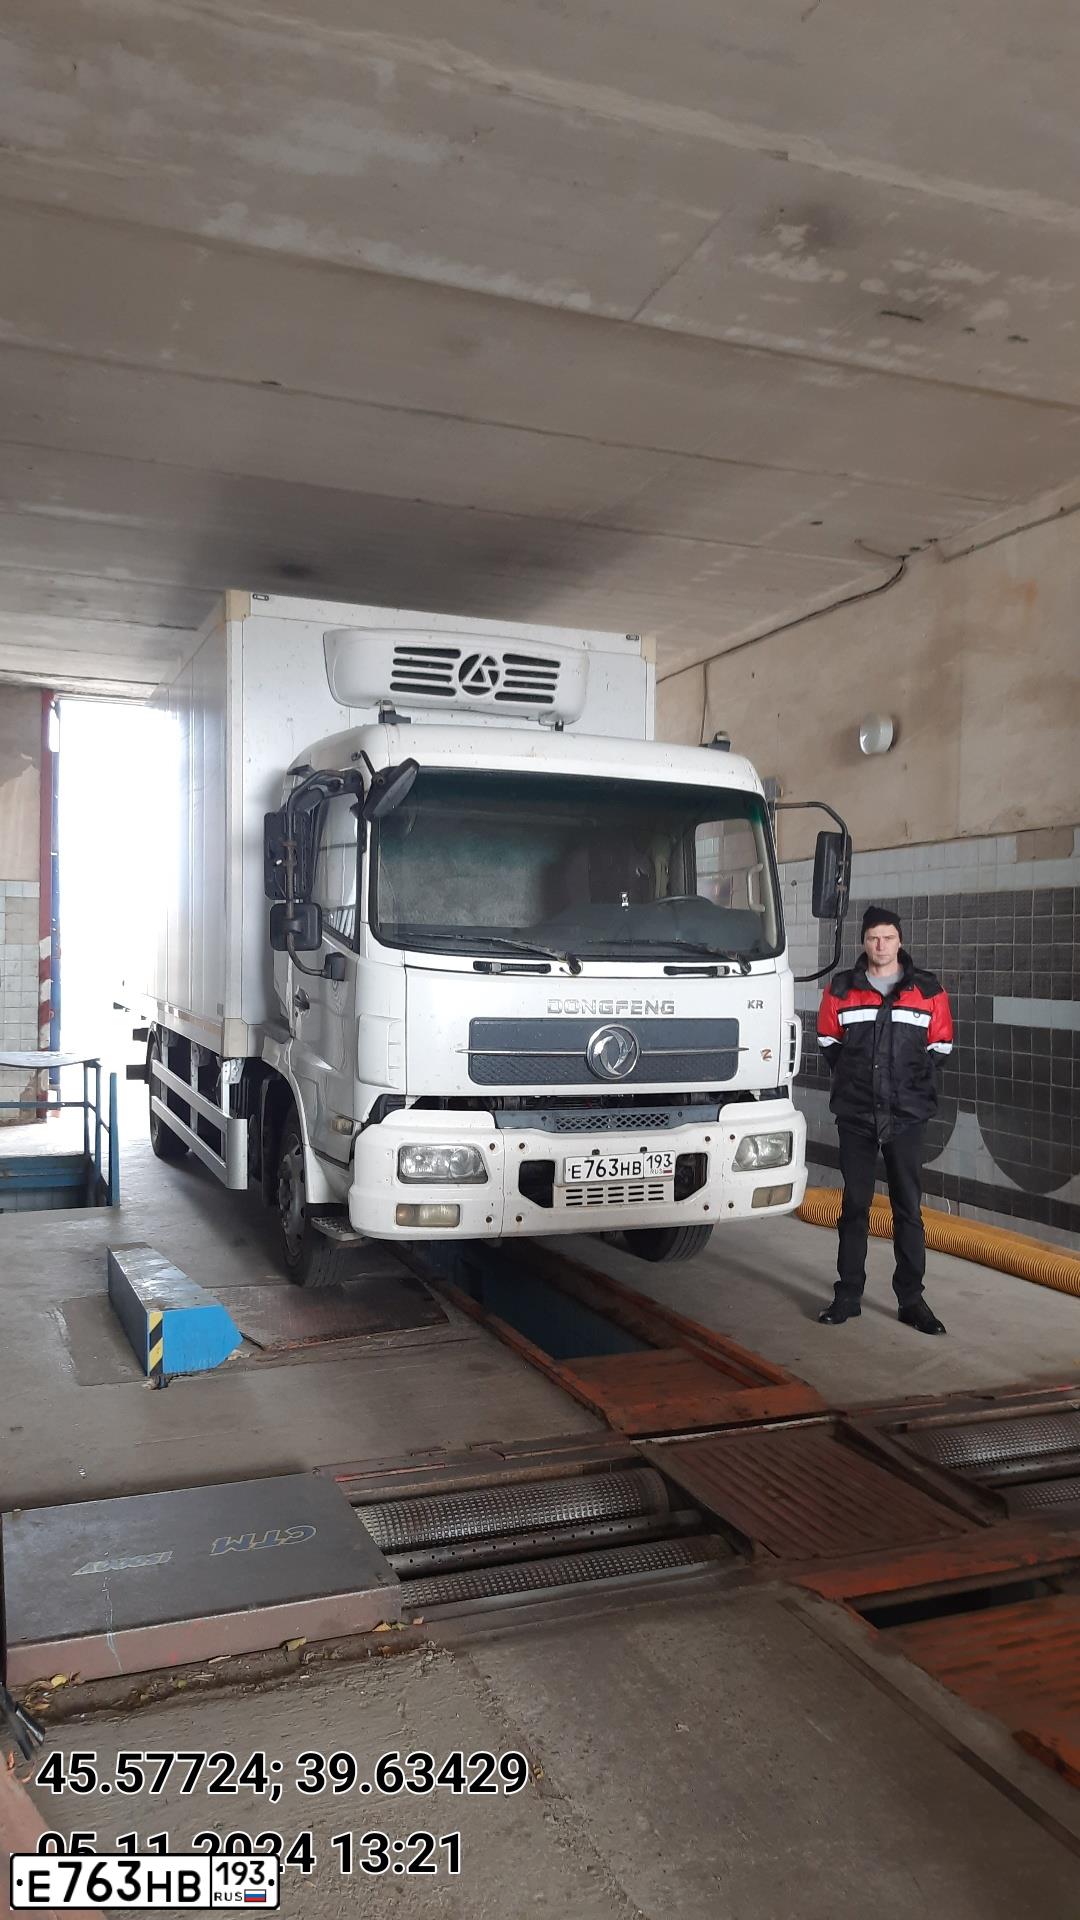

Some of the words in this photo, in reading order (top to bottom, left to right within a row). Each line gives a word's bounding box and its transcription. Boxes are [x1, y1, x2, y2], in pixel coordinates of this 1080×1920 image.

[547, 998, 675, 1015] DONGFENG
[747, 999, 764, 1009] KR
[646, 1153, 672, 1169] 193
[650, 1167, 663, 1175] RUS
